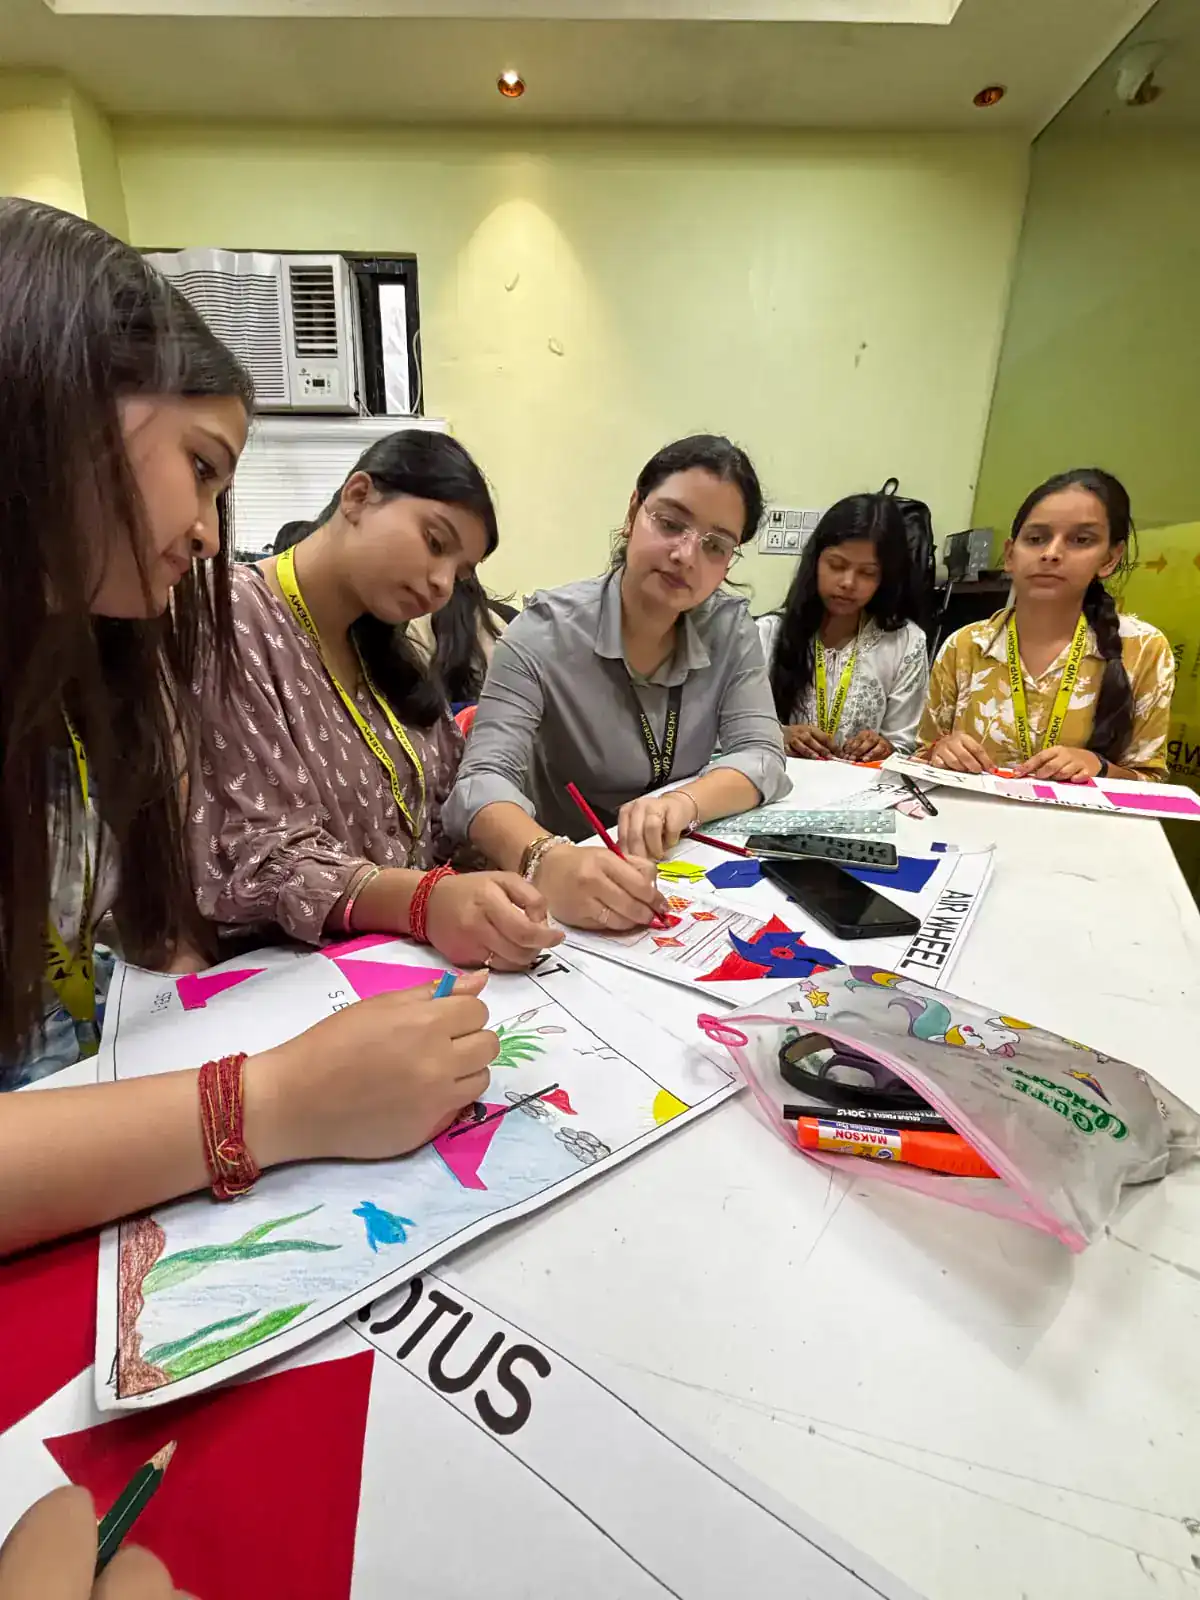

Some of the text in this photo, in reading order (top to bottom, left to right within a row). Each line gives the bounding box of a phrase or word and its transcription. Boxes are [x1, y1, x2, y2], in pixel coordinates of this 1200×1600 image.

[1007, 630, 1017, 668] ACADEMY
[1064, 625, 1087, 684] IWP ACADEMY
[665, 710, 677, 755] ACADEMY
[900, 889, 974, 970] AIR WHEEL
[835, 1129, 888, 1145] MAKSON
